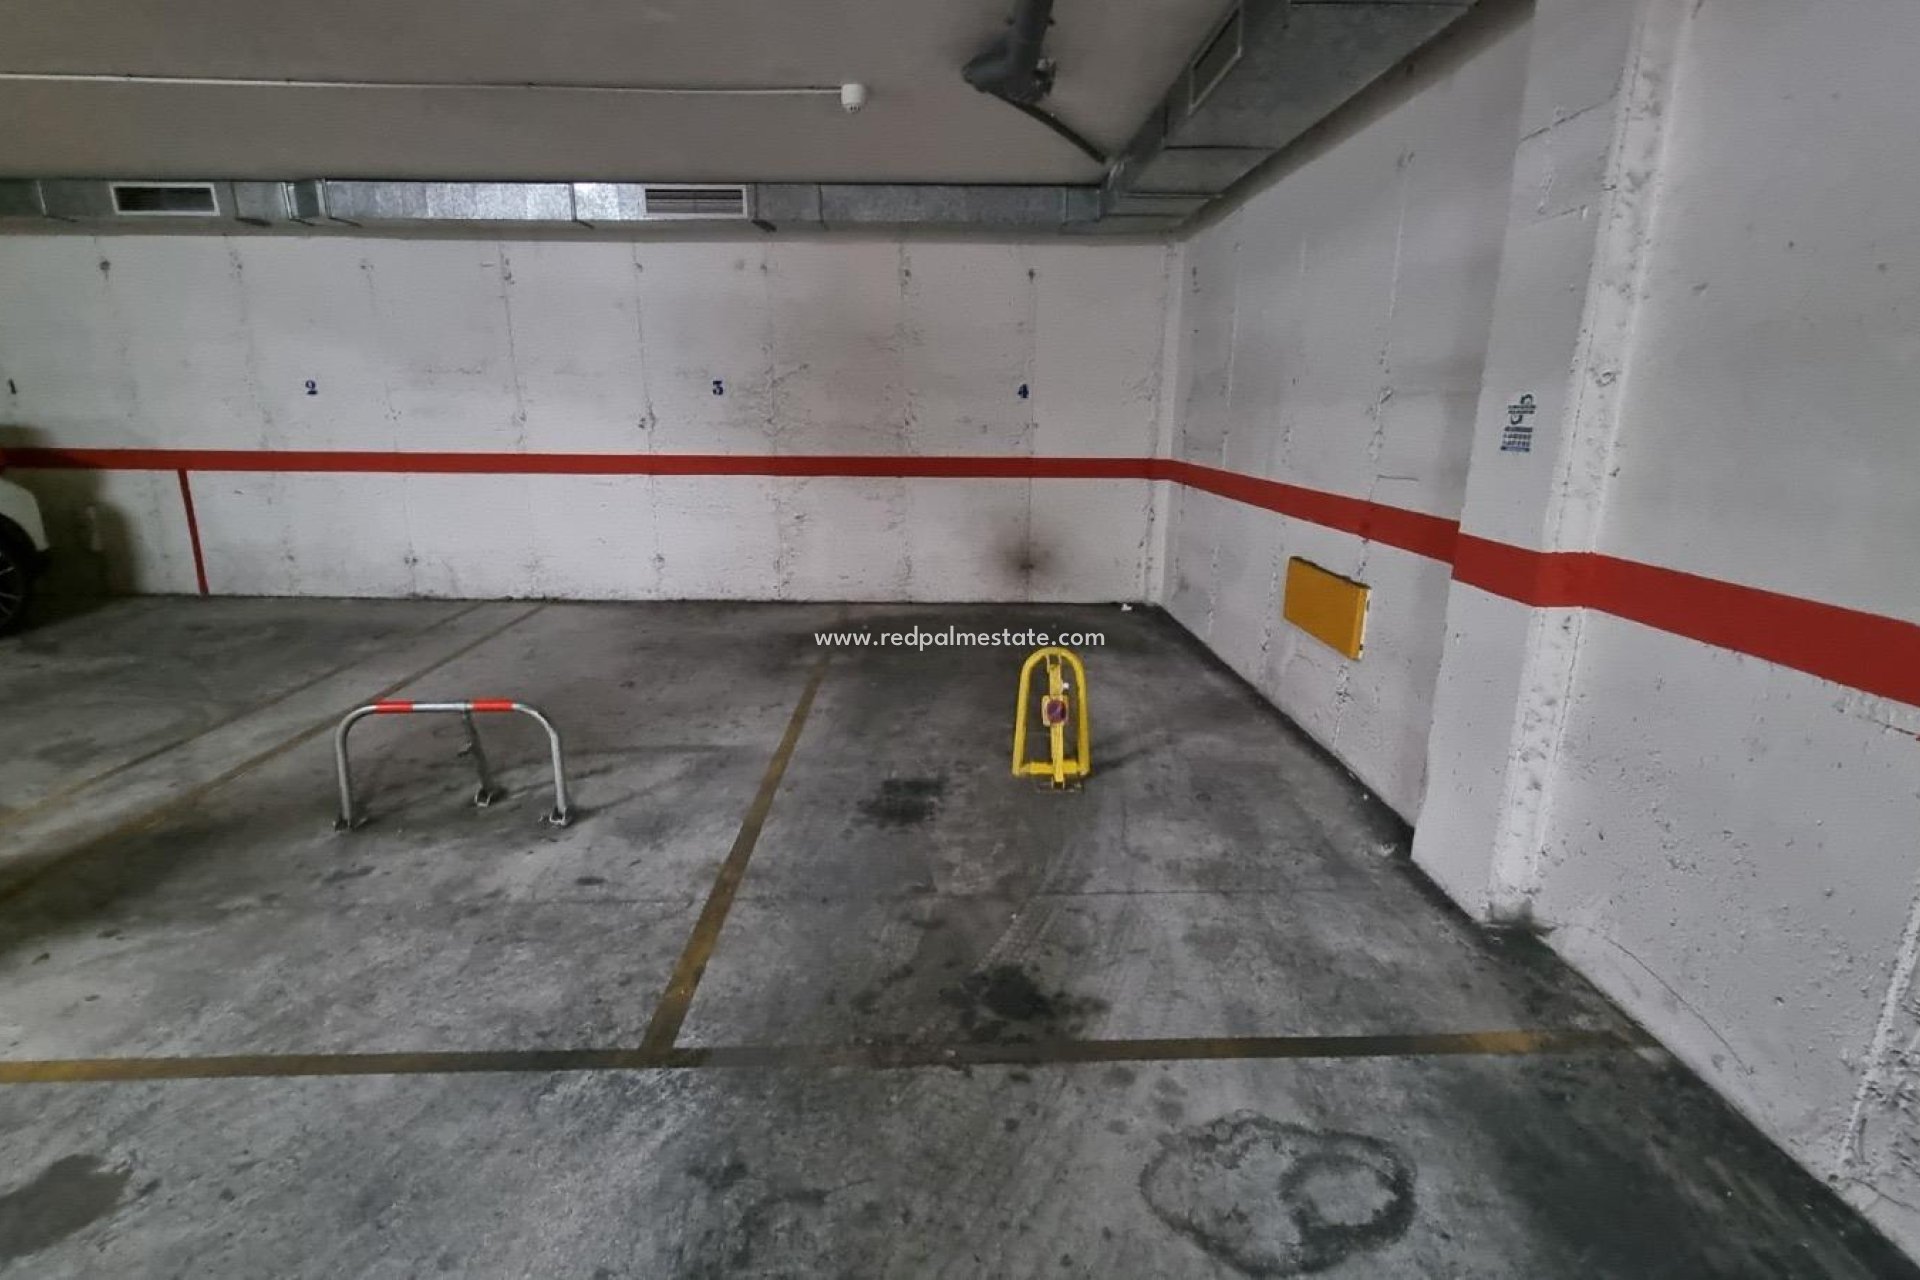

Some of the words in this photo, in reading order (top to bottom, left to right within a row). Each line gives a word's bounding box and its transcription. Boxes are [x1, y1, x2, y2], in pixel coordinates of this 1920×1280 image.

[305, 380, 318, 396] 2
[712, 380, 724, 396] 3
[1018, 384, 1030, 399] 4
